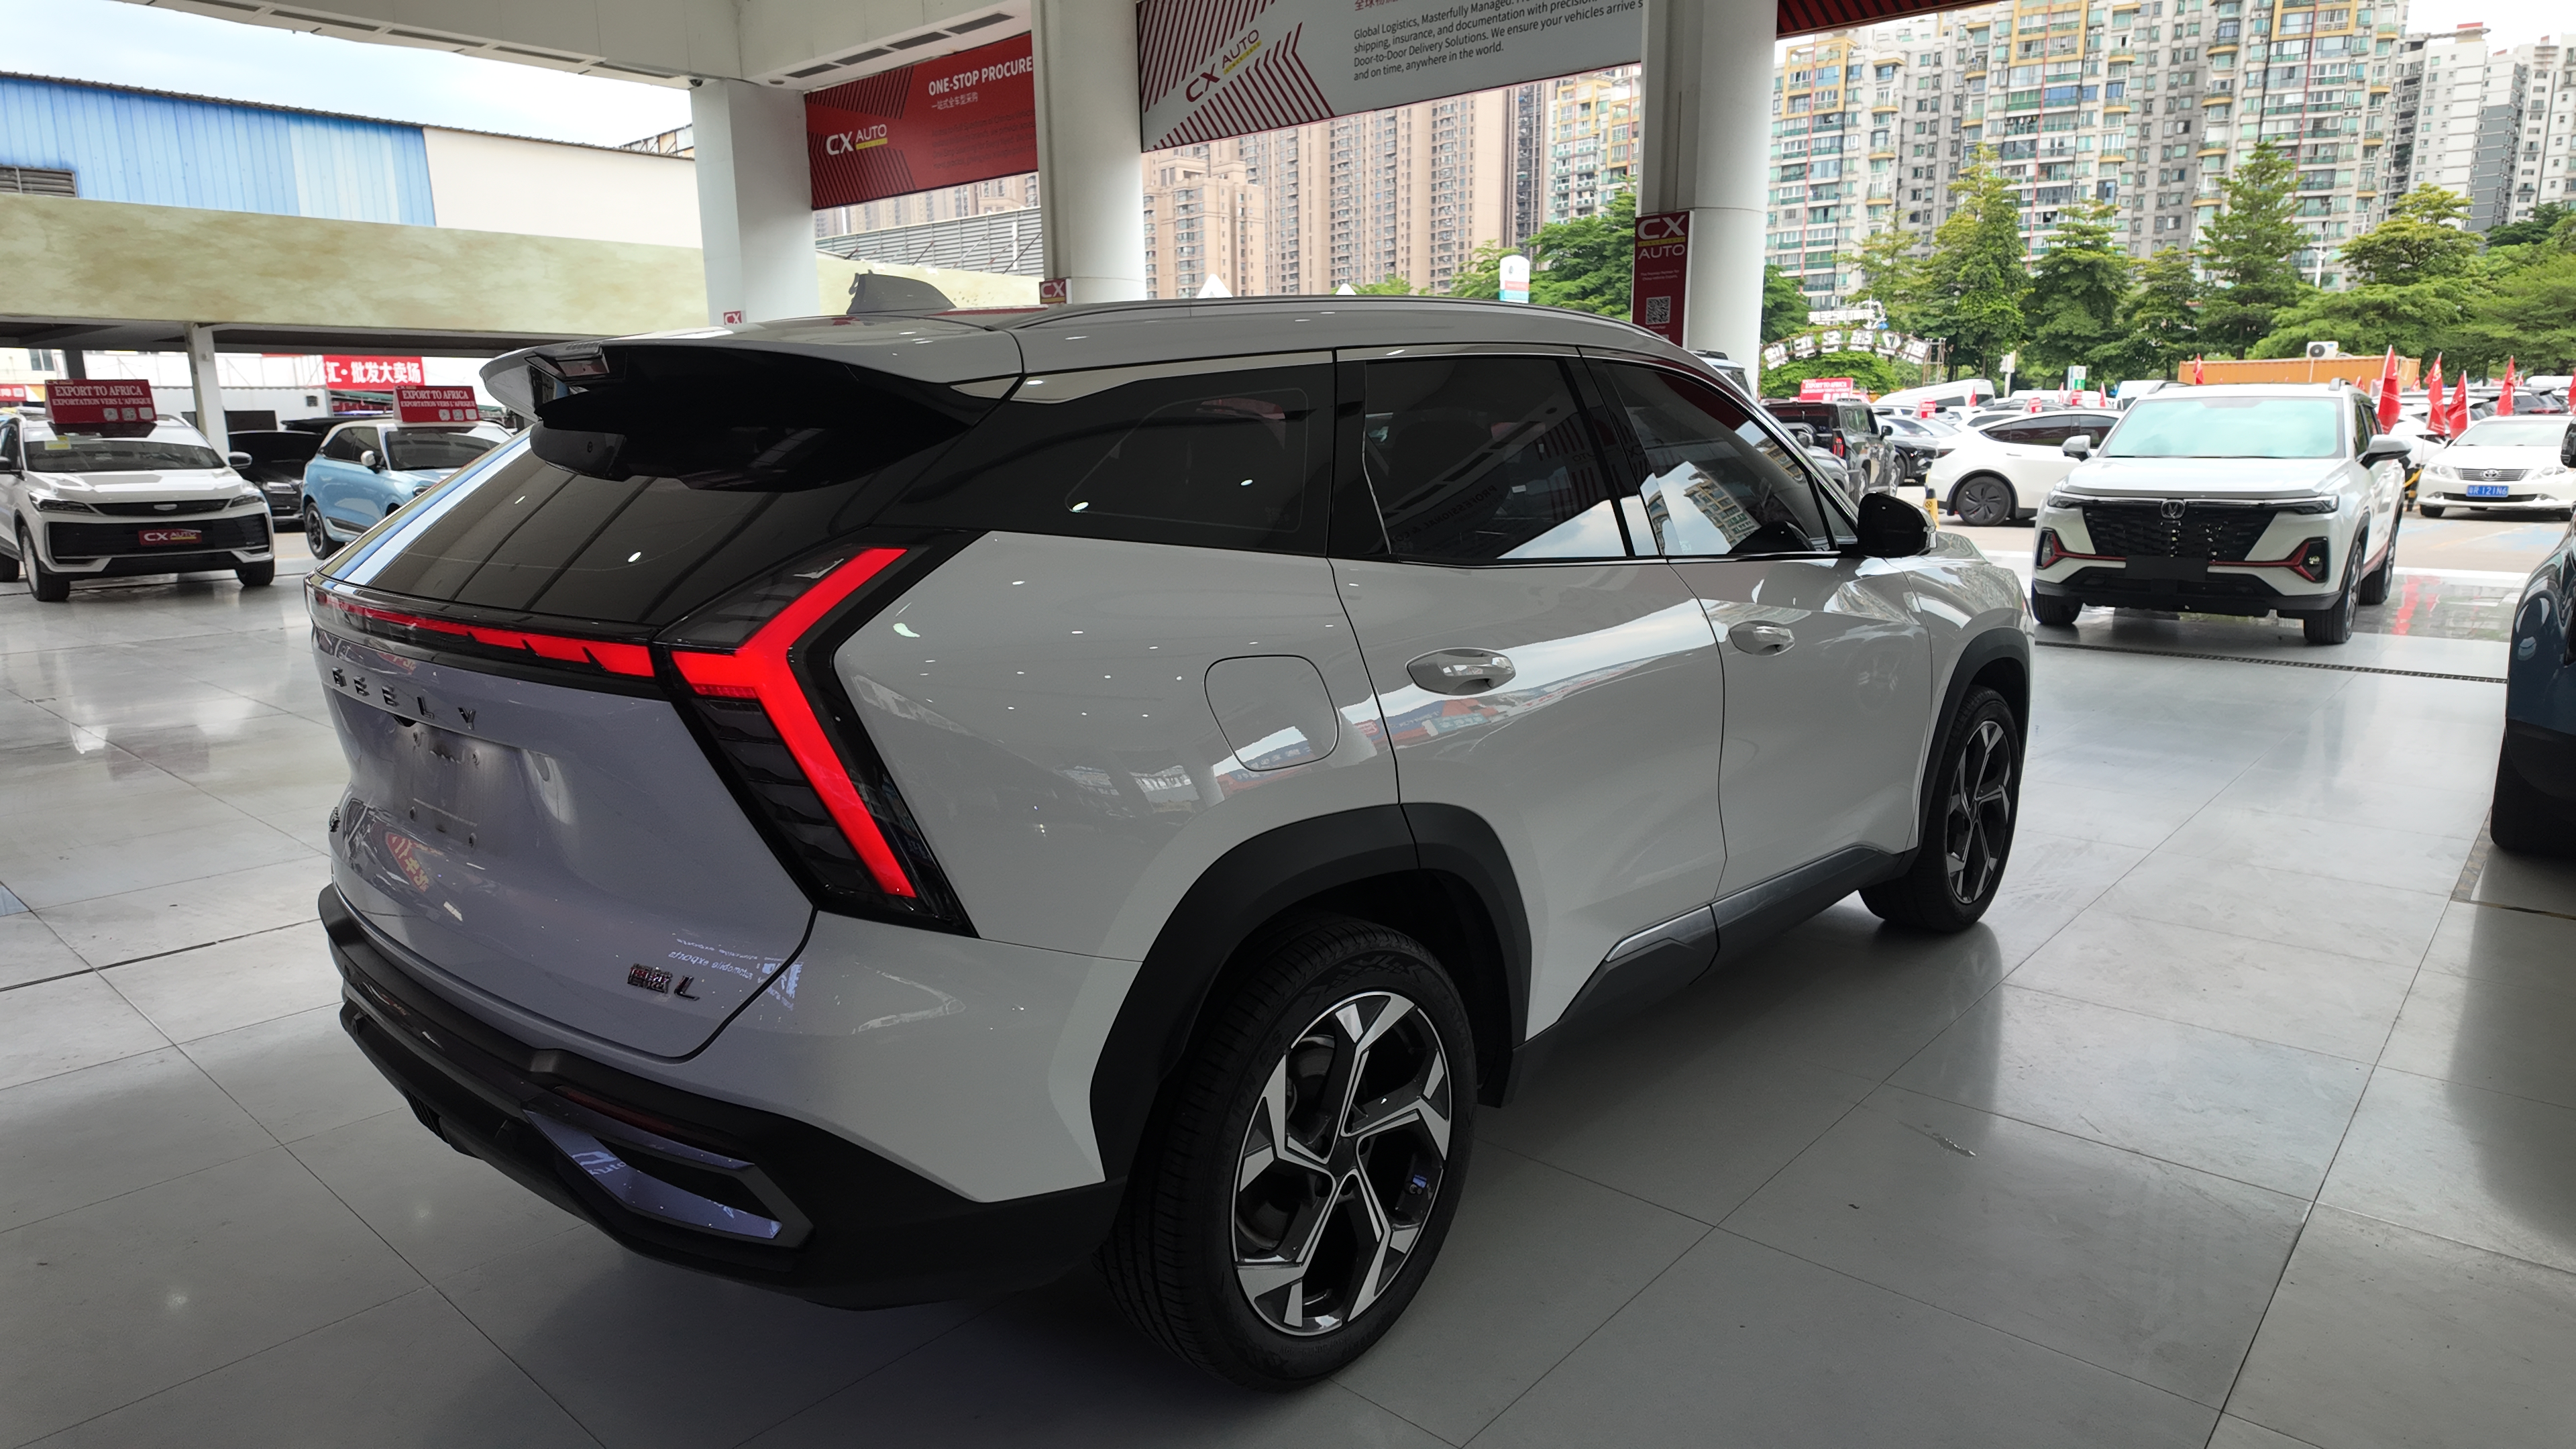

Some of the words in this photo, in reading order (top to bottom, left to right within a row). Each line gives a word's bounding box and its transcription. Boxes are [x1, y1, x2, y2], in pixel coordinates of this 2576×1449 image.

[1354, 23, 1380, 40] Global
[1381, 18, 1420, 34] Logistics,
[1421, 5, 1468, 25] Masterfully
[1470, 0, 1514, 13] Managed.
[1354, 39, 1391, 54] shipping,
[1393, 29, 1436, 45] insurance,
[1437, 22, 1454, 36] and
[1455, 9, 1525, 32] documentation
[1527, 3, 1548, 16] with
[1354, 48, 1407, 67] Door-to-Door
[1409, 41, 1443, 56] Delivery
[1445, 32, 1489, 48] Solutions.
[1491, 28, 1505, 38] We
[1507, 21, 1538, 35] ensure
[1541, 15, 1562, 31] your
[1564, 7, 1604, 23] vehicles
[1607, 1, 1635, 14] arrive
[1185, 62, 1220, 102] CX
[1222, 30, 1259, 68] AUTO
[1354, 68, 1369, 80] and
[1371, 69, 1381, 78] on
[1383, 62, 1404, 74] time,
[1405, 54, 1448, 71] anywhere
[1449, 51, 1457, 62] in
[1459, 48, 1474, 60] the
[1476, 41, 1504, 56] world.
[928, 70, 979, 96] ONE-STOP
[981, 56, 1032, 83] PROCURE
[826, 131, 854, 156] CX
[855, 124, 887, 143] AUTO
[1638, 215, 1686, 240] CX
[1638, 244, 1686, 260] AUTO
[1040, 282, 1065, 298] CX
[724, 313, 740, 324] CX
[325, 361, 422, 384] 汇·批发大卖场
[52, 398, 100, 407] EXPORTATION
[54, 386, 93, 396] EXPORT
[94, 386, 108, 396] TO
[109, 386, 144, 396] AFRICA
[402, 390, 431, 400] EXPORT
[431, 390, 442, 400] TO
[443, 390, 469, 399] AFRICA
[144, 533, 168, 541] CX
[674, 975, 700, 1001] L
